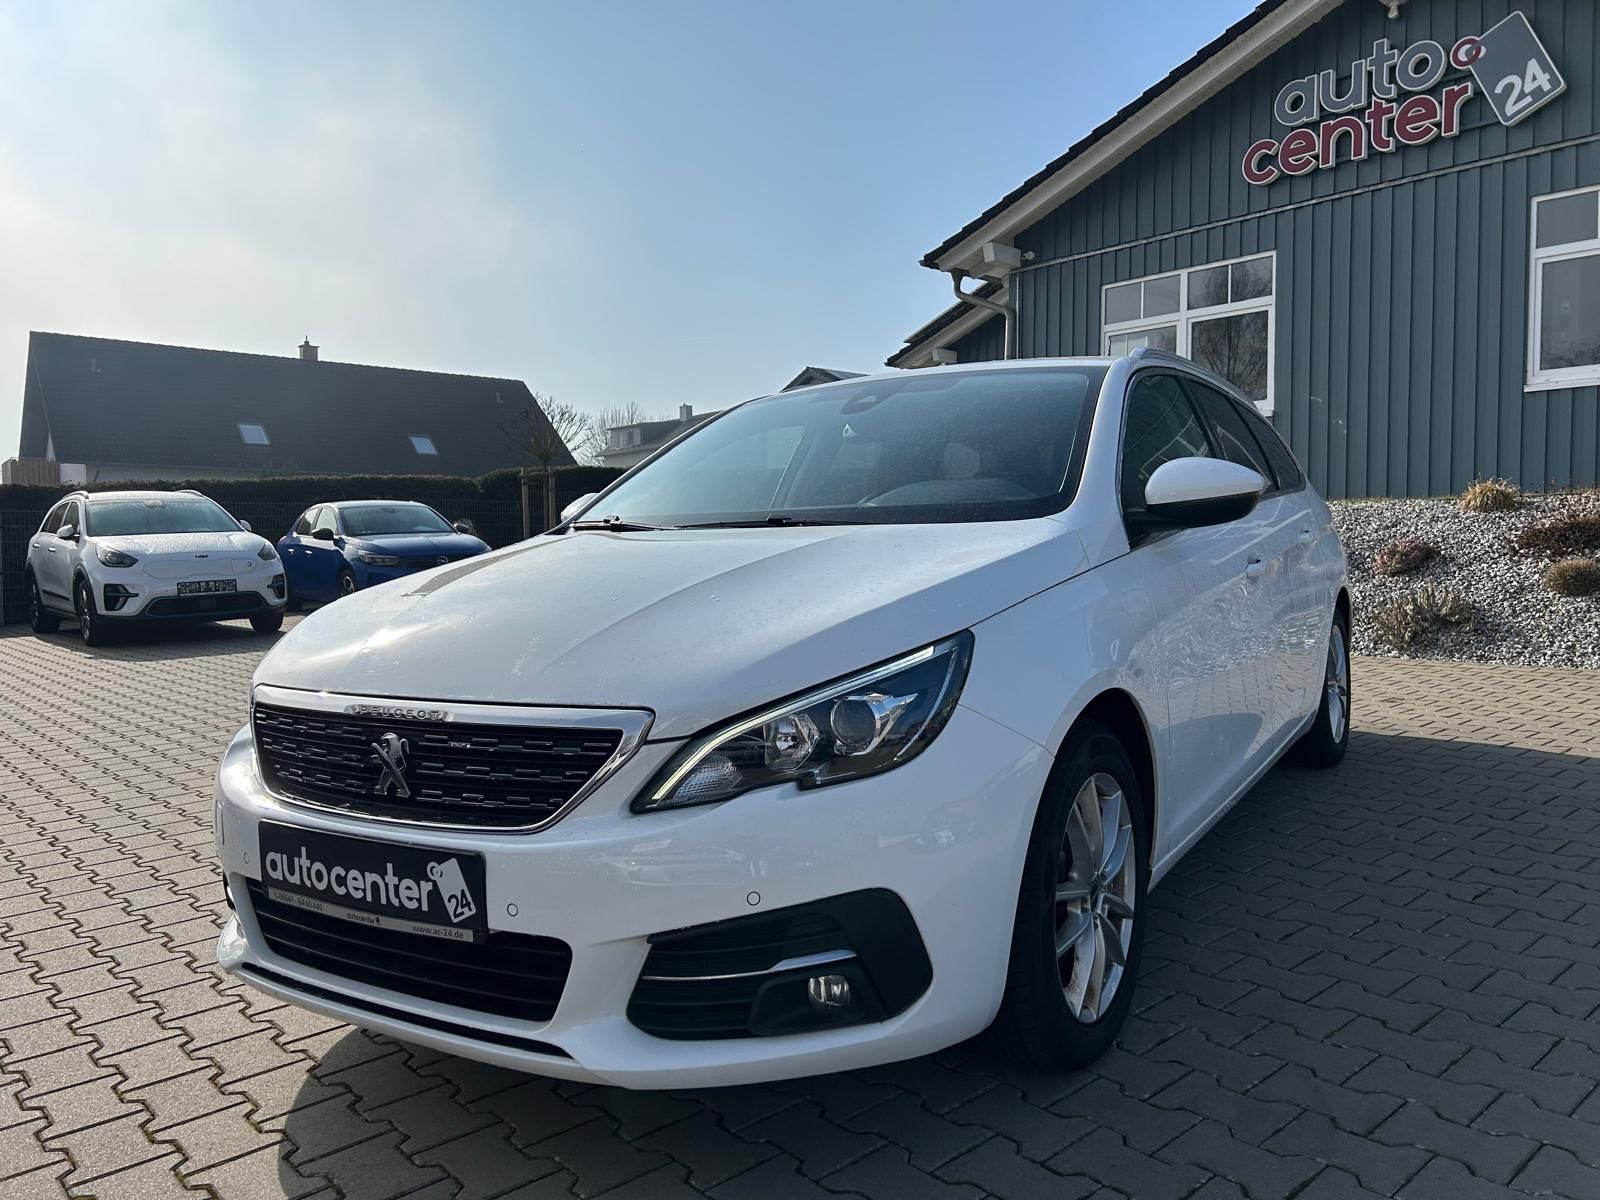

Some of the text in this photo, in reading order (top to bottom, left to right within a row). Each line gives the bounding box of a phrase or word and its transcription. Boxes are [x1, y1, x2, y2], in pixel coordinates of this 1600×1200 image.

[1274, 38, 1447, 126] auto
[1494, 58, 1551, 117] 24
[1242, 81, 1474, 185] center
[360, 704, 440, 720] PEUGEOT
[265, 846, 433, 912] autocenter
[447, 888, 473, 919] 24
